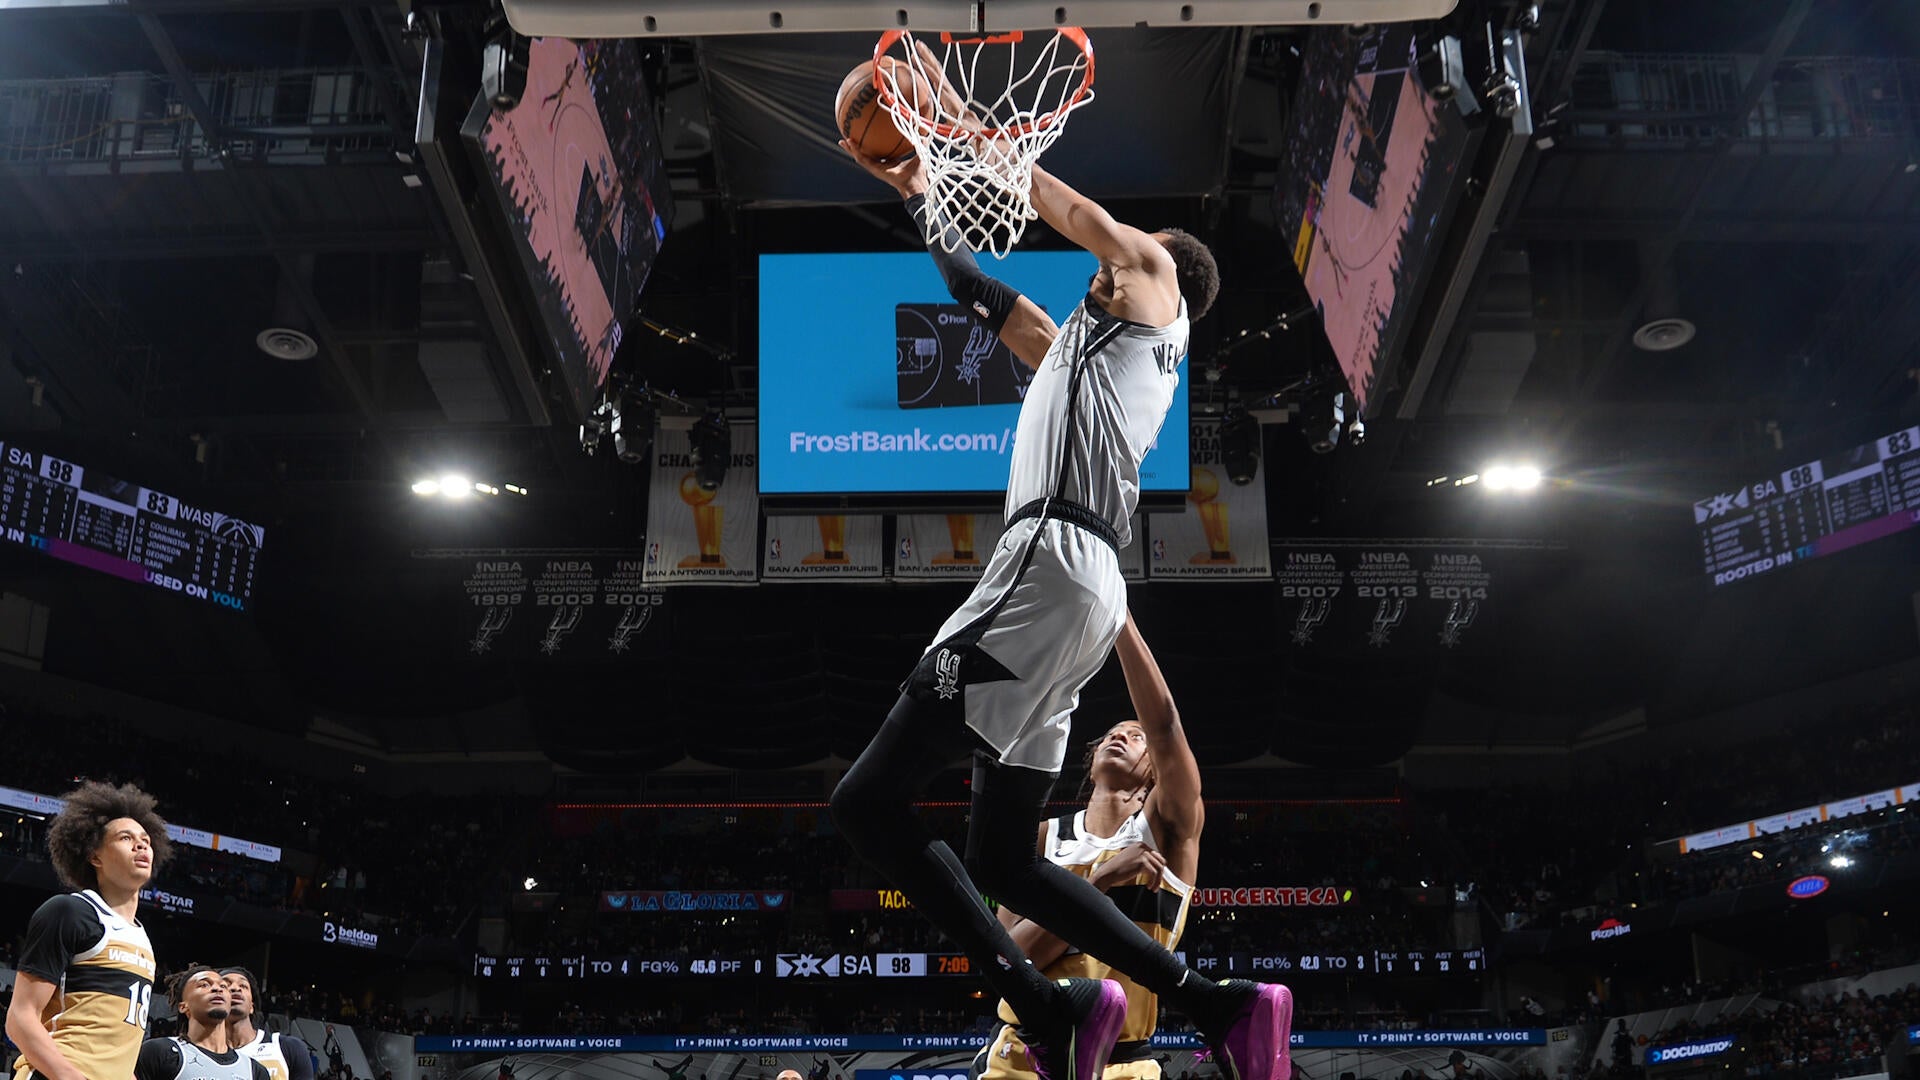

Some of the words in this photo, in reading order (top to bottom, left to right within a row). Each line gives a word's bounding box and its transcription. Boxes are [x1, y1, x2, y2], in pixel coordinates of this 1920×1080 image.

[1887, 431, 1911, 455] 83
[8, 447, 33, 470] SA
[49, 460, 73, 482] 98
[658, 454, 755, 467] CHANS
[1752, 479, 1778, 500] SA
[1790, 466, 1812, 488] 98
[147, 492, 169, 514] 83
[179, 502, 213, 528] WAS
[7, 527, 25, 544] IN
[149, 521, 187, 538] COULIBALY
[148, 529, 192, 550] CARRINGTON
[146, 539, 182, 557] JOHNSON
[145, 548, 174, 565] GEORGE
[1295, 553, 1336, 564] NBA
[1369, 552, 1410, 564] NBA
[1440, 554, 1482, 565] NBA
[144, 558, 164, 570] SARR
[483, 561, 523, 572] NBA
[552, 561, 593, 572] NBA
[792, 565, 840, 573] ANTONIO
[1285, 563, 1336, 571] WESTERN
[1714, 556, 1775, 586] ROOTED
[1775, 550, 1793, 567] IN
[645, 569, 667, 577] SAN
[669, 568, 716, 577] ANTONIO
[718, 569, 754, 577] SPURS
[1276, 570, 1344, 578] CONFERENCE
[1350, 570, 1420, 578] CONFERENCE
[1422, 571, 1491, 580] CONFERENCE
[463, 578, 529, 587] CONFERENCE
[1279, 577, 1343, 585] CHAMPIONS
[1353, 577, 1417, 585] CHAMPIONS
[1425, 578, 1489, 586] CHAMPIONS
[143, 569, 183, 592] USED
[185, 582, 208, 600] ON
[211, 590, 245, 612] YOU.
[466, 585, 527, 593] CHAMPIONS
[1281, 586, 1341, 598] 2007
[1357, 586, 1418, 598] 2013
[1429, 586, 1488, 600] 2014
[470, 593, 523, 606] 1999
[536, 594, 595, 606] 2003
[605, 594, 664, 606] 2005
[160, 891, 194, 909] STAR
[1190, 886, 1340, 907] BURGERTECA
[631, 895, 660, 911] LA
[338, 925, 378, 944] beldon
[478, 956, 497, 965] REB
[561, 957, 579, 966] BLK
[591, 960, 613, 974] TO
[620, 959, 629, 975] 4
[640, 960, 680, 974] FG%
[720, 960, 742, 974] PF
[754, 959, 762, 975] 0
[843, 955, 873, 975] SA
[892, 957, 911, 973] 98
[937, 955, 970, 974] 7:05
[1196, 957, 1218, 970] PF
[1228, 956, 1234, 971] 1
[1252, 956, 1292, 970] FG%
[1299, 955, 1320, 970] 42.0
[1325, 956, 1348, 969] TO
[1357, 954, 1365, 970] 3
[1380, 951, 1398, 961] BLK
[1434, 951, 1453, 961] AST
[1463, 950, 1481, 960] REB
[124, 981, 152, 1030] 18
[452, 1038, 463, 1048] IT
[473, 1038, 507, 1048] PRINT
[516, 1038, 577, 1048] SOFTWARE
[587, 1038, 622, 1048] VOICE
[675, 1037, 686, 1048] IT
[697, 1037, 732, 1048] PRINT
[741, 1037, 803, 1048] SOFTWARE
[813, 1037, 848, 1047] VOICE
[903, 1037, 913, 1047] IT
[925, 1037, 959, 1047] PRINT
[1153, 1035, 1187, 1045] PRINT
[1358, 1033, 1369, 1043] IT
[1380, 1033, 1414, 1043] PRINT
[1423, 1032, 1484, 1042] SOFTWARE
[1494, 1030, 1530, 1041] VOICE
[420, 1057, 435, 1066] 127
